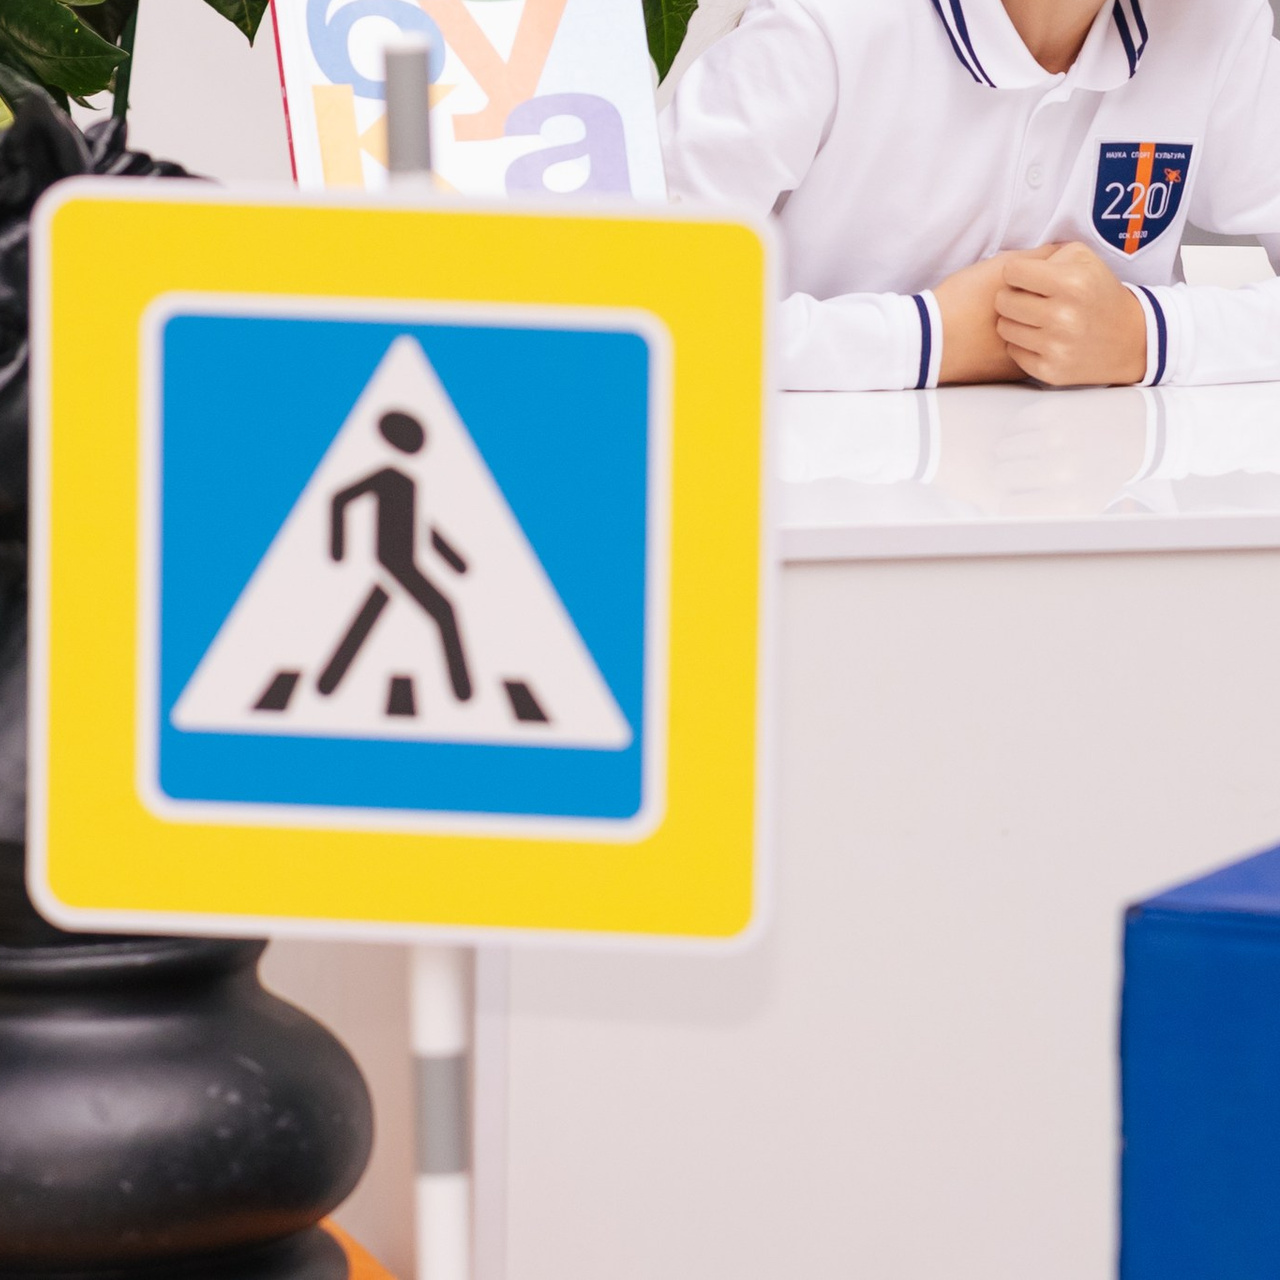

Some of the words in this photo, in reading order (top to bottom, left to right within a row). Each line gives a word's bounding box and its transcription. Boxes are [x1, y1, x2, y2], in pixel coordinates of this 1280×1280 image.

[1105, 151, 1127, 159] НАУКА
[1130, 151, 1151, 159] СПОРТ
[1154, 152, 1186, 160] КУЛЬТУРА
[1101, 181, 1171, 220] 220
[1132, 230, 1148, 239] 2020
